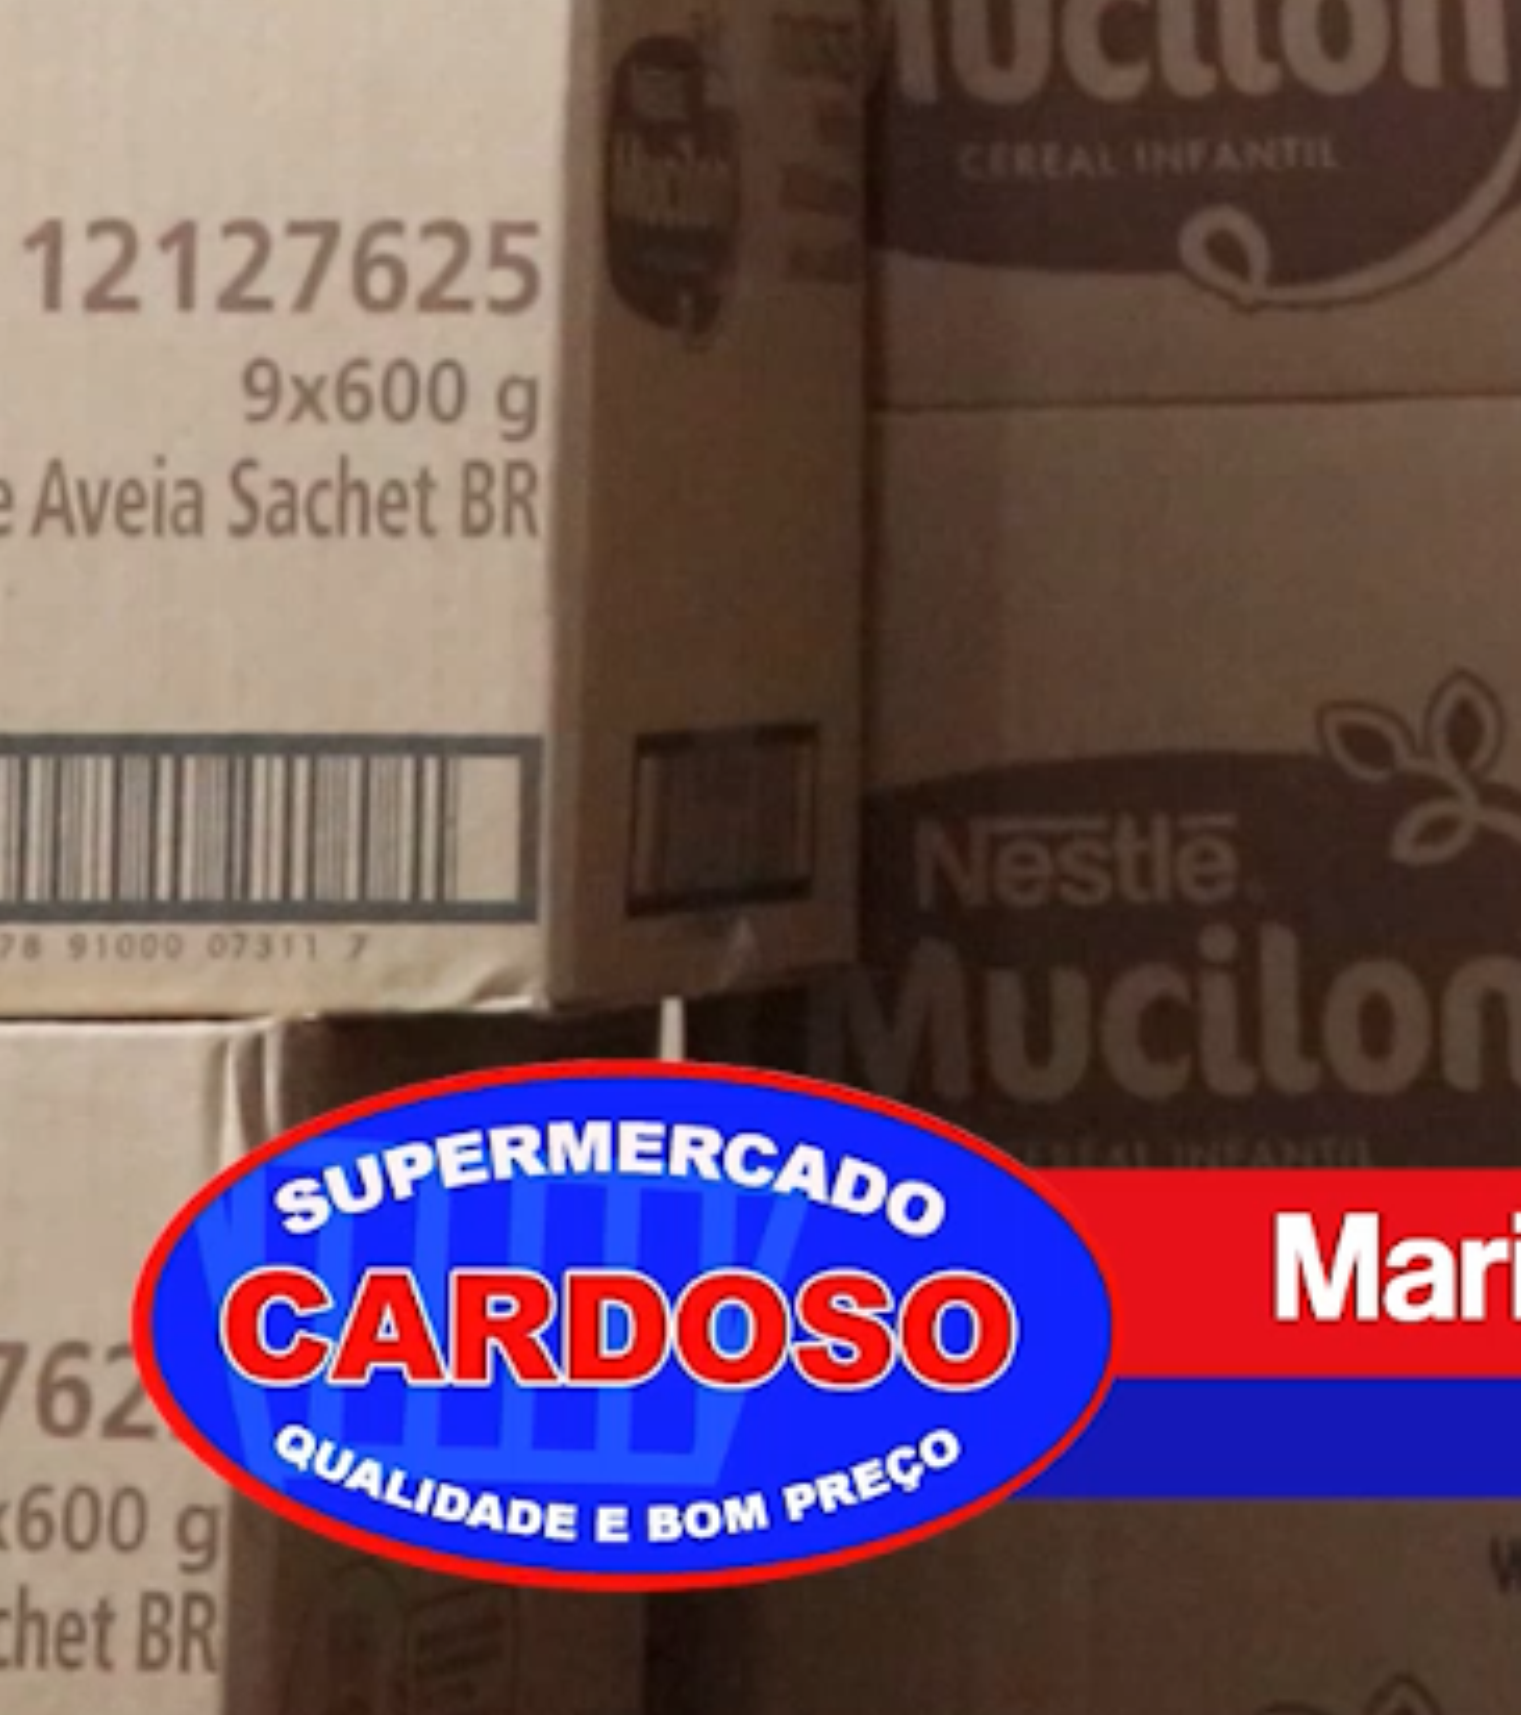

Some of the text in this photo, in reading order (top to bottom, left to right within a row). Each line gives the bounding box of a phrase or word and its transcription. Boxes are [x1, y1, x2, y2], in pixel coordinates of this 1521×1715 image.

[960, 134, 1341, 182] CEREAL INFANTIL
[21, 219, 542, 314] 12127625
[241, 357, 540, 442] 9x600 g
[30, 453, 203, 538] Aveia
[228, 455, 438, 539] Sachet
[460, 460, 540, 539] BR
[916, 811, 1239, 911] Nestlé
[67, 932, 184, 962] 91000
[206, 932, 318, 962] 07311
[347, 932, 368, 962] 7
[0, 1340, 162, 1440] 762
[175, 1502, 222, 1574] g
[138, 1589, 220, 1674] BR
